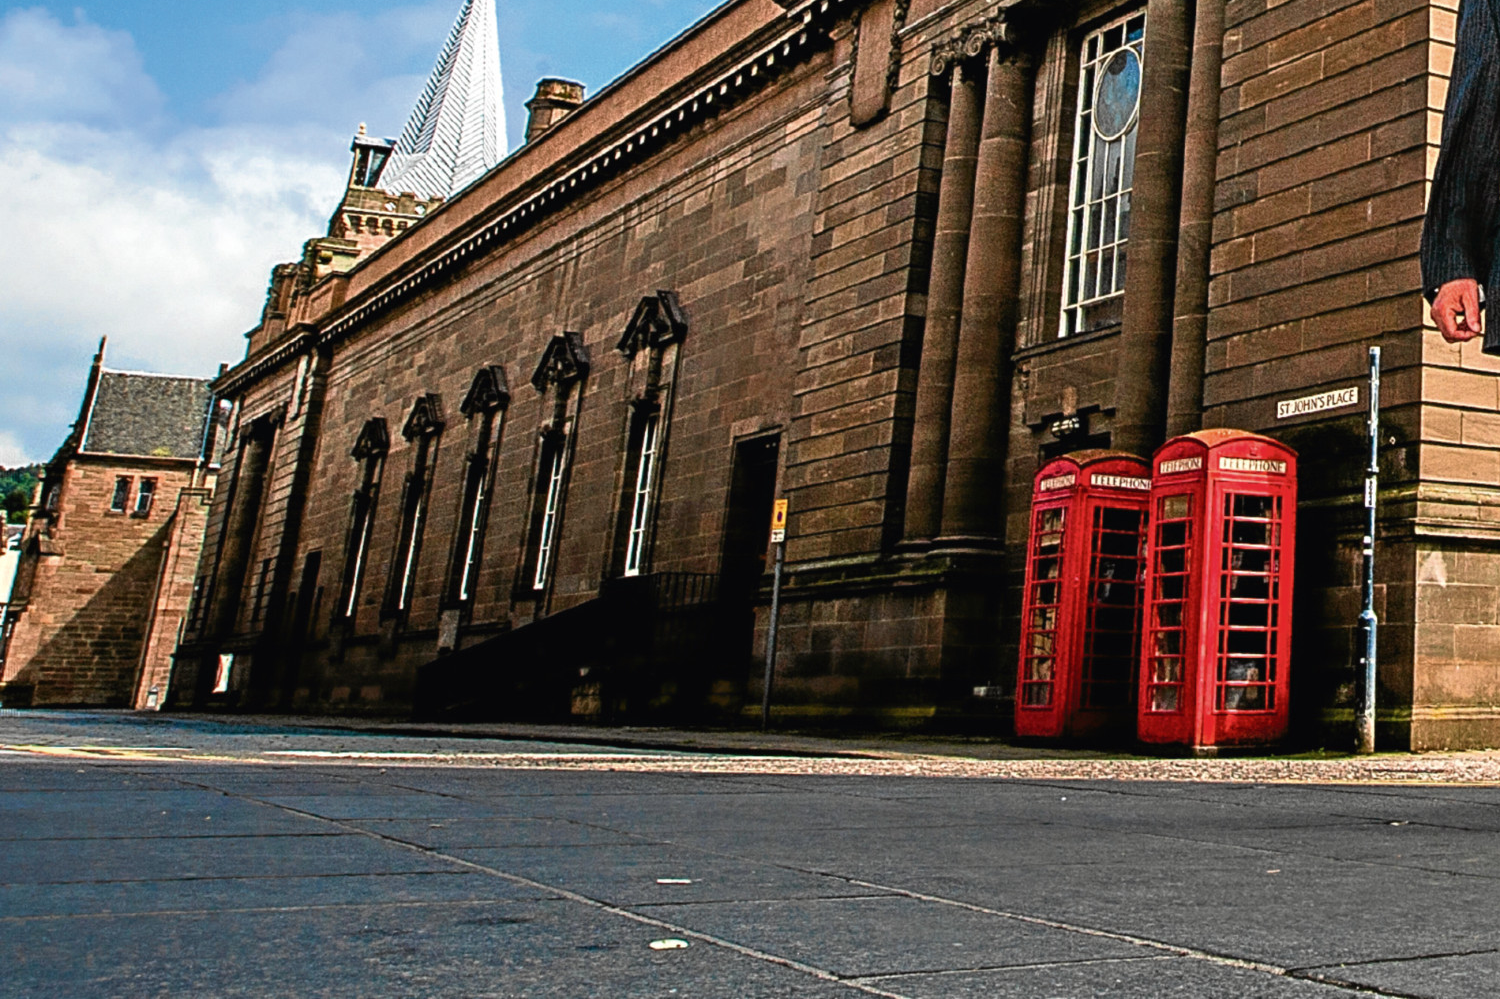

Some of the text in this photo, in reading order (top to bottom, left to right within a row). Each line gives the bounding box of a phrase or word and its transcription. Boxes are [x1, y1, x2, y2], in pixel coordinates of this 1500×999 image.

[1279, 389, 1355, 416] ST JOHN'S PLACE
[1162, 458, 1200, 472] TELEPHON
[1222, 458, 1283, 472] TELEPHONE
